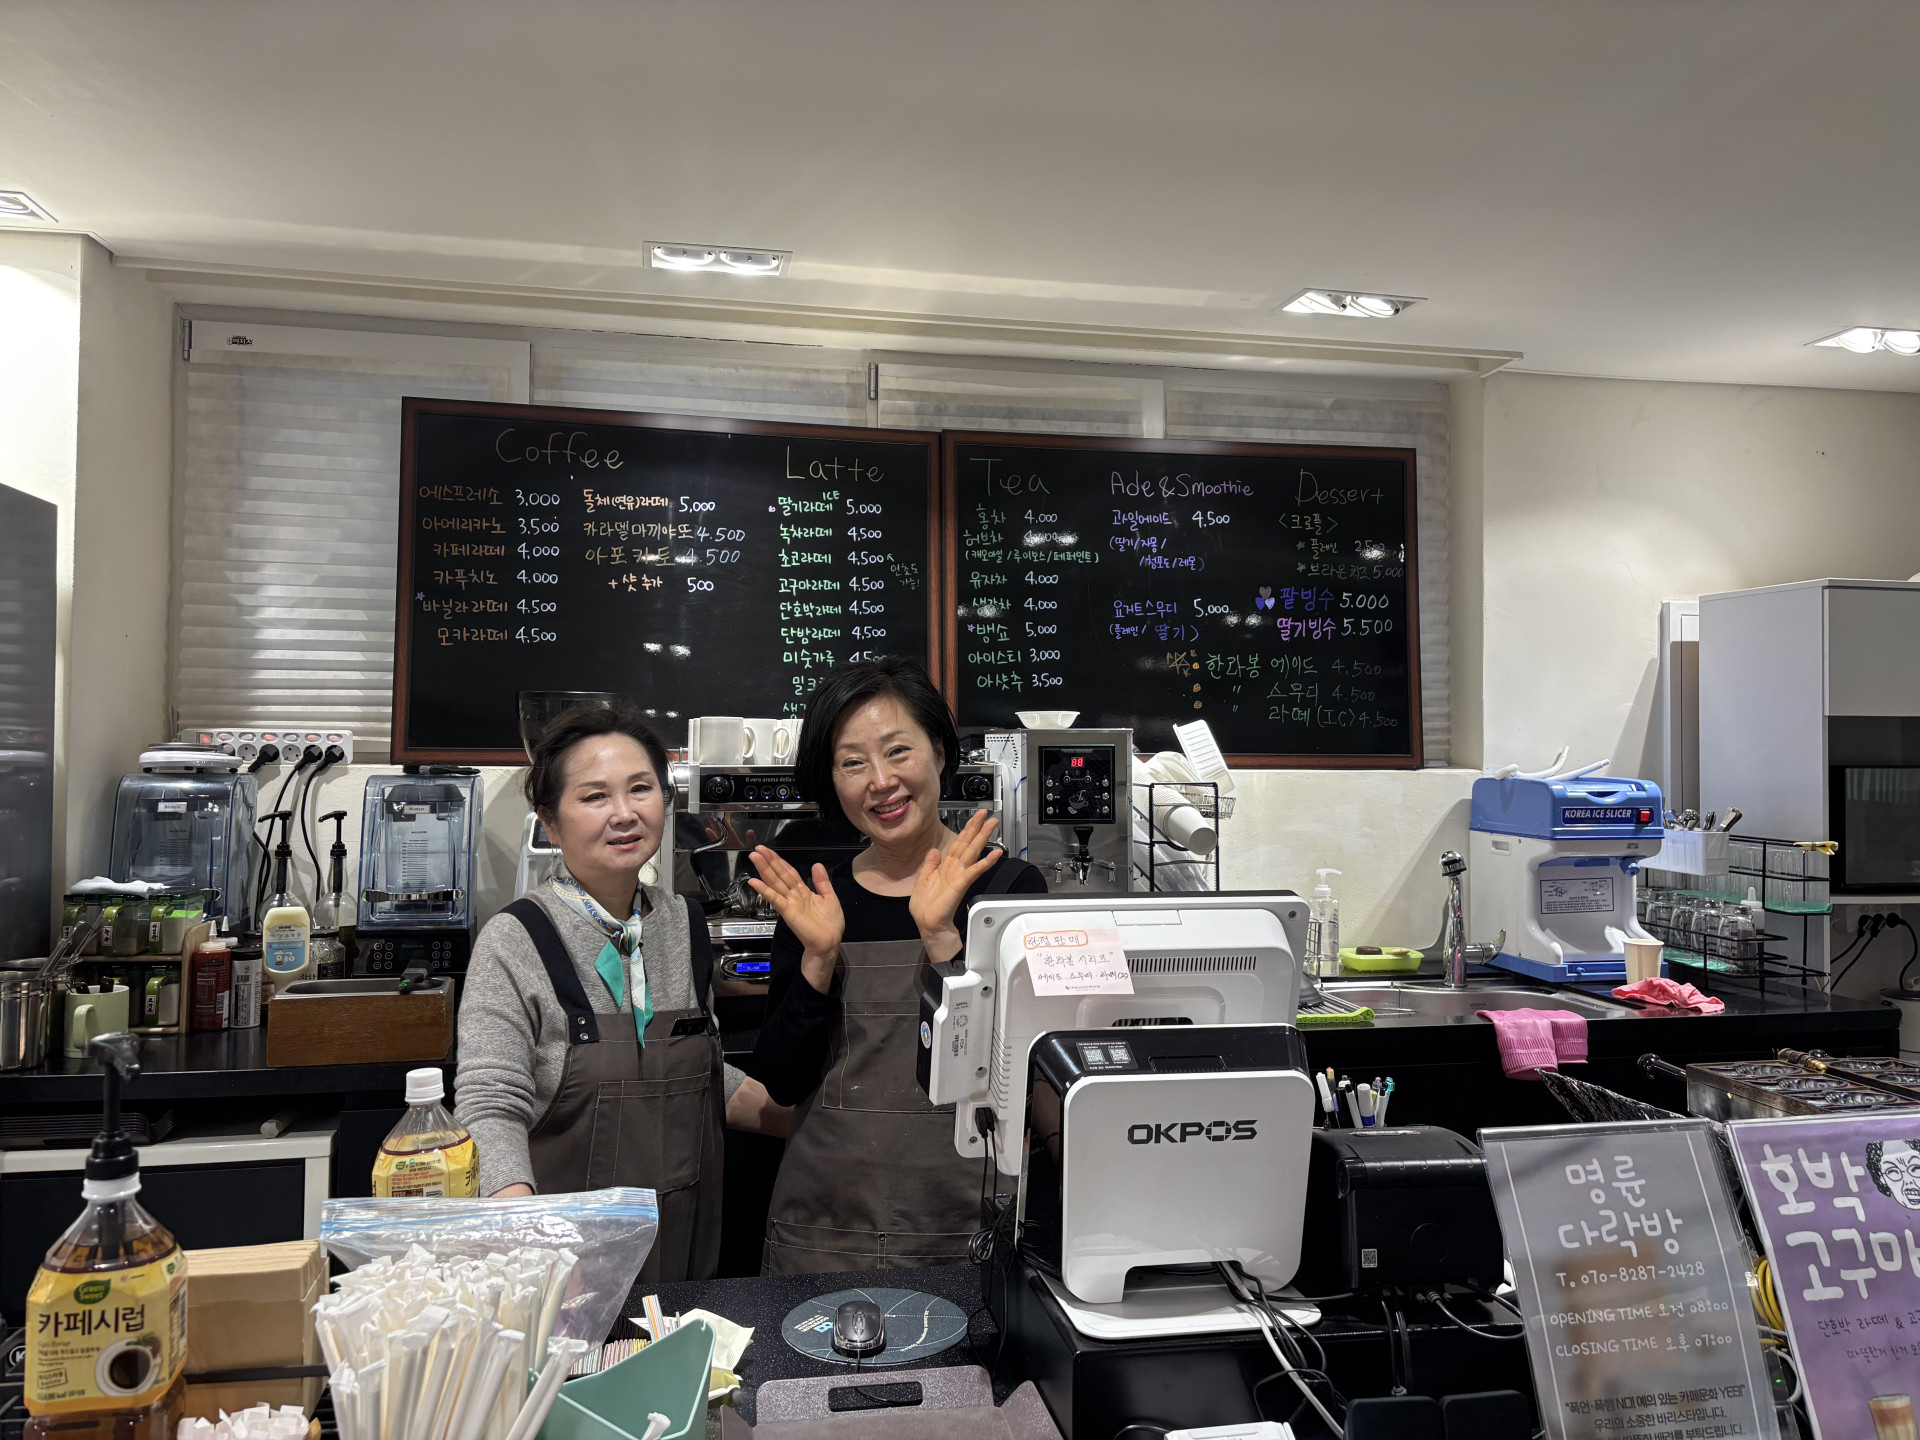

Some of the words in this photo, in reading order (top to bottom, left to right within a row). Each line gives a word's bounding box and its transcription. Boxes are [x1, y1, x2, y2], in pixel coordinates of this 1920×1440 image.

[496, 428, 624, 469] Coffee
[786, 445, 884, 482] Latte
[969, 457, 1051, 496] Tea
[1111, 470, 1154, 498] Ade
[1159, 476, 1175, 498] &
[1177, 473, 1254, 497] Smoothie
[419, 485, 503, 505] 에스프레소
[822, 490, 840, 501] ICE
[1295, 468, 1384, 507] Dessert
[583, 489, 668, 513] 돌체(연유)라떼
[778, 496, 833, 516] 딸기라떼
[423, 516, 506, 534] 아메리카노
[976, 503, 1007, 530] 홍차
[1112, 509, 1173, 531] 과일에이드
[780, 523, 832, 546] 녹차라떼
[963, 529, 1004, 547] 허브차
[433, 543, 505, 558] 카페라떼
[778, 548, 832, 568] 초코라떼
[1311, 538, 1338, 559] 플레인
[434, 569, 499, 591] 카푸치노
[623, 575, 637, 591] 샷
[642, 576, 663, 591] 추가
[687, 578, 714, 592] 500
[778, 578, 840, 596] 고구마라떼
[969, 571, 1008, 589] 유자차
[1114, 600, 1178, 618] 요거트스무디
[1280, 587, 1334, 611] 팥빙수
[423, 600, 508, 620] 바닐라라떼
[780, 601, 842, 620] 단호박라떼
[438, 628, 508, 646] 모카라떼
[781, 626, 841, 644] 단밤라떼
[976, 623, 1010, 643] 뱅쇼
[1277, 618, 1337, 642] 딸기빙수
[784, 649, 836, 669] 미숫가루
[968, 649, 1021, 664] 아이스티
[1205, 652, 1261, 679] 한라봉
[1270, 656, 1318, 679] 에이드
[977, 671, 1024, 692] 아샷추
[1266, 682, 1319, 706] 스무디
[1269, 706, 1311, 727] 라떼
[1565, 809, 1591, 818] KOREA
[1592, 809, 1604, 818] ICE
[1606, 809, 1632, 818] SLICER
[1127, 1119, 1258, 1145] OKPOS
[1564, 1155, 1647, 1207] 명륜
[1760, 1144, 1866, 1222] 호박
[1558, 1208, 1684, 1258] 다락방
[1785, 1227, 1920, 1302] 고구마
[38, 1304, 145, 1338] 카페시럽
[1550, 1308, 1616, 1328] OPENING
[1616, 1304, 1653, 1320] TIME
[1658, 1301, 1685, 1318] 오전
[1818, 1318, 1851, 1338] 단호박
[1857, 1314, 1888, 1329] 라떼
[1895, 1317, 1904, 1329] &
[1556, 1338, 1621, 1357] CLOSING
[1622, 1336, 1658, 1351] TIME
[1665, 1332, 1690, 1352] 오후
[1658, 1392, 1678, 1405] 있는
[1679, 1388, 1718, 1403] 카페문화
[1594, 1417, 1625, 1431] 우리의
[1626, 1413, 1655, 1429] 소중한
[1657, 1407, 1727, 1425] 바리스타입니다.
[1685, 1424, 1746, 1439] 부탁드립니다.
